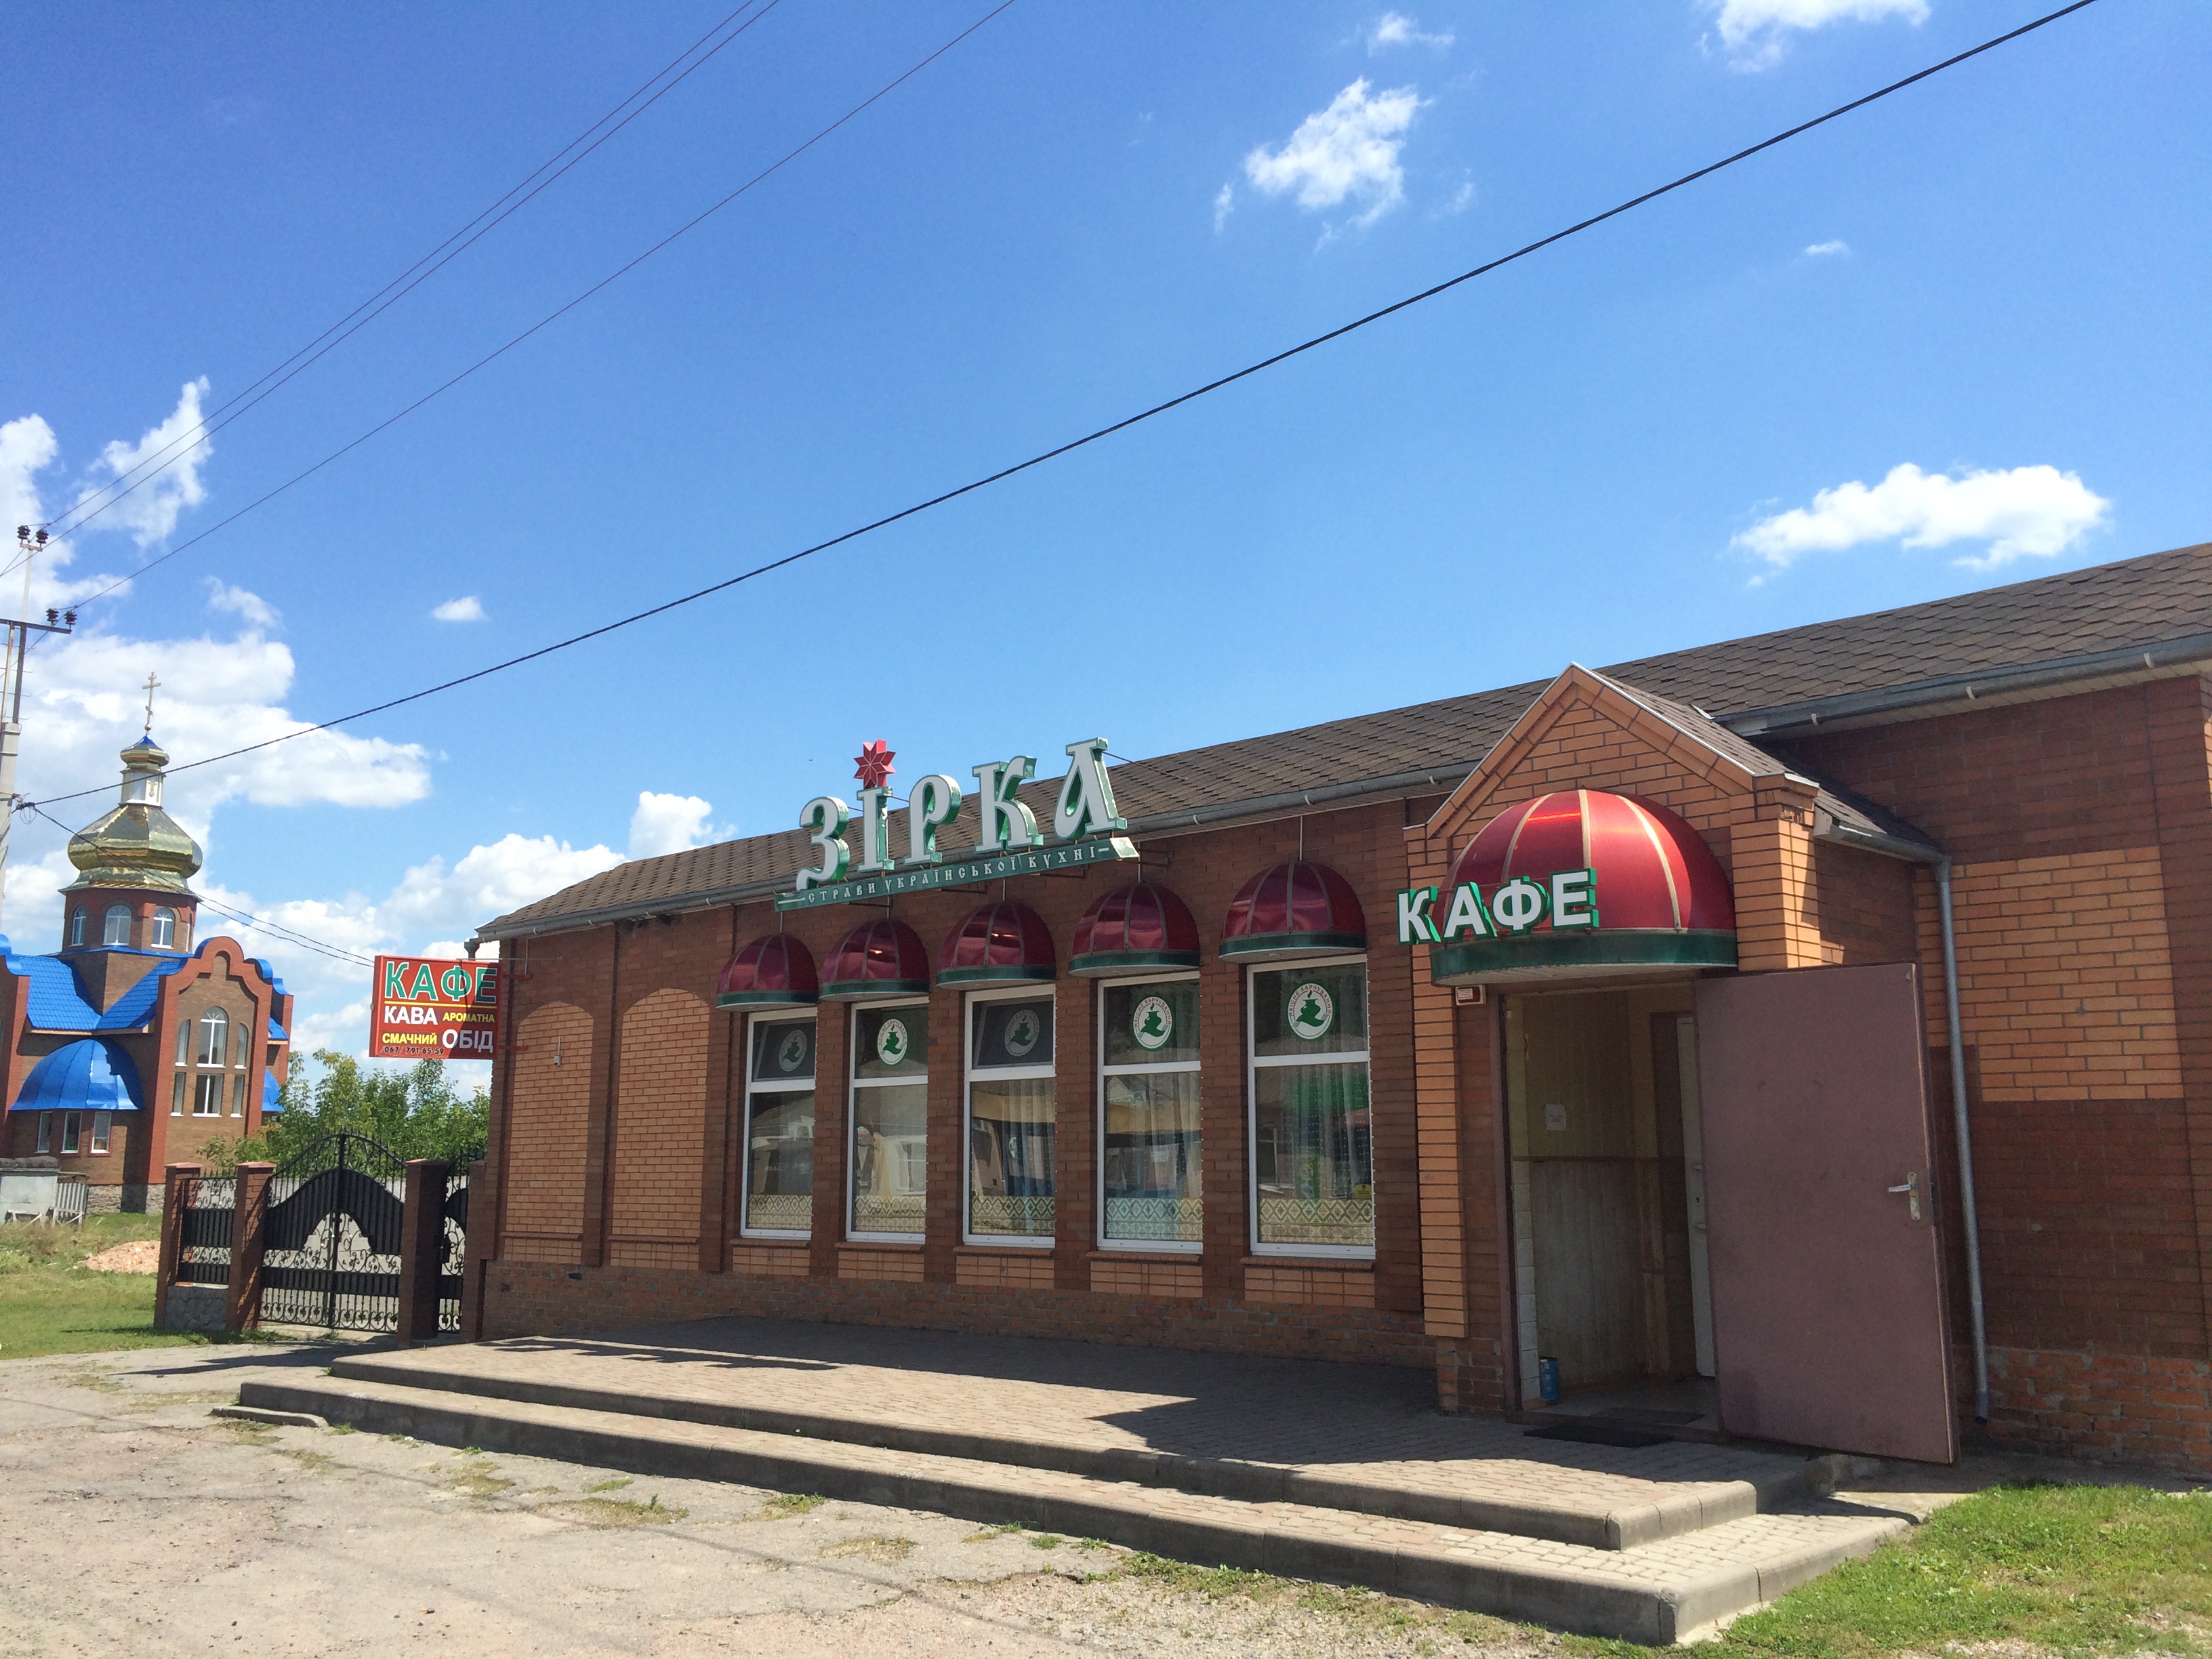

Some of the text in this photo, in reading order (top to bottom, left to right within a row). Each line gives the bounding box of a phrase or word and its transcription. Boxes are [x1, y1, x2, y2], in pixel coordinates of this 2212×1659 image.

[796, 737, 1128, 892] ЗІРКА
[808, 846, 1096, 903] СТРАВИ УКРАЇНСЬКОЇ КУХНІ
[1396, 867, 1599, 945] КАФЕ
[384, 961, 498, 1004] КАФЕ
[384, 1006, 495, 1025] КАВА АРОМАТНА
[382, 1029, 494, 1053] СМАЧНИЙ ОБІД
